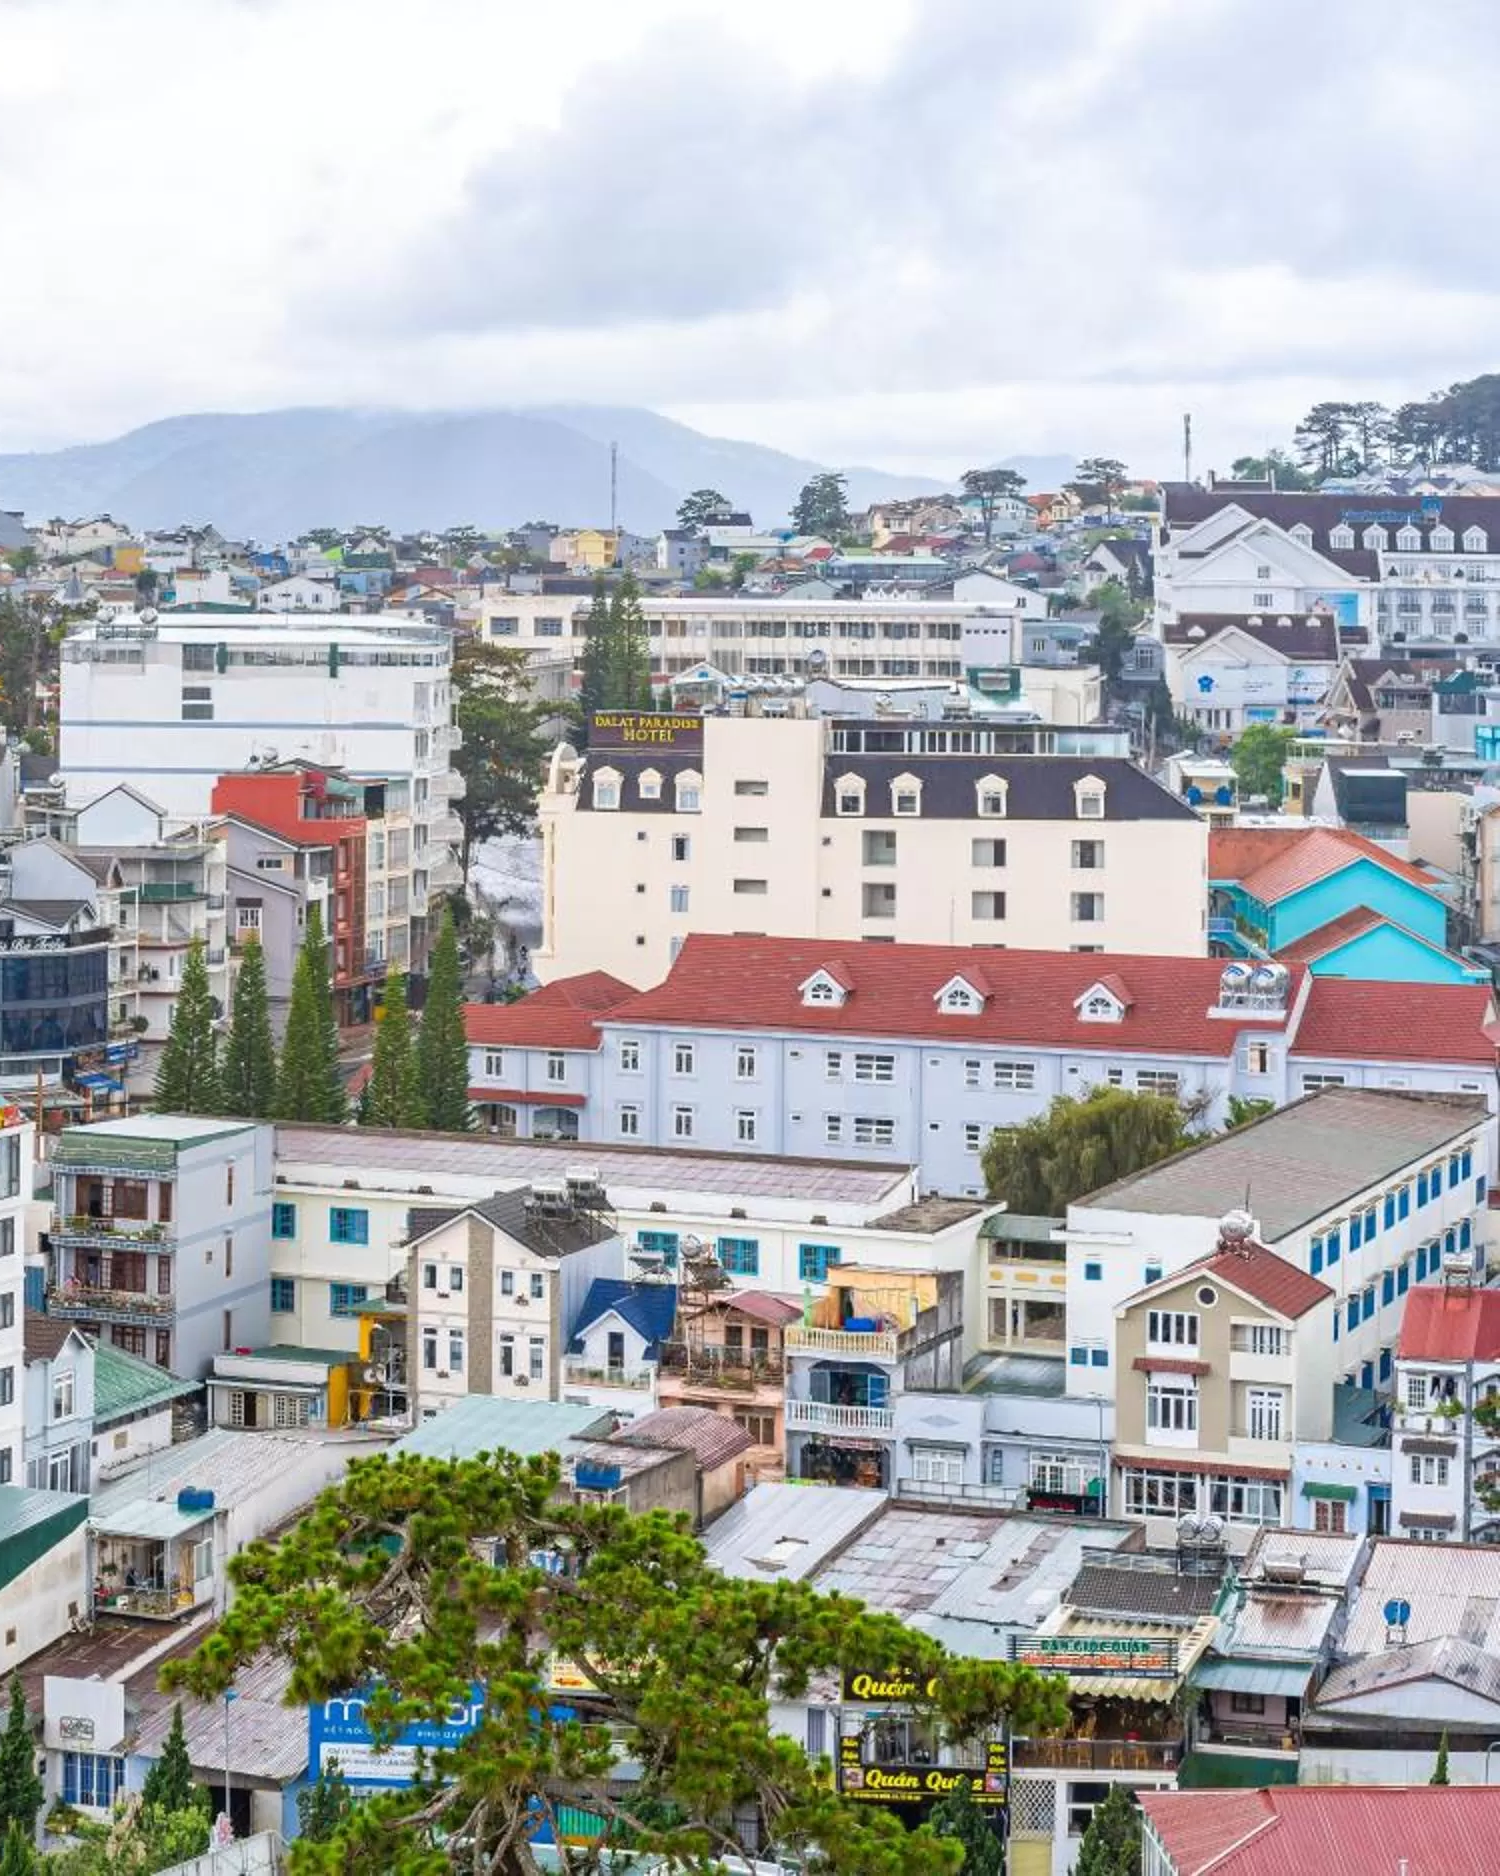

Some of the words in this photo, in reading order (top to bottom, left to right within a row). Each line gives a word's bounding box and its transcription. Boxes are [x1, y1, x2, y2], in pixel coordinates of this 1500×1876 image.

[639, 717, 700, 730] PARADISE
[623, 728, 675, 743] HOTEL
[865, 1768, 920, 1789] Quán
